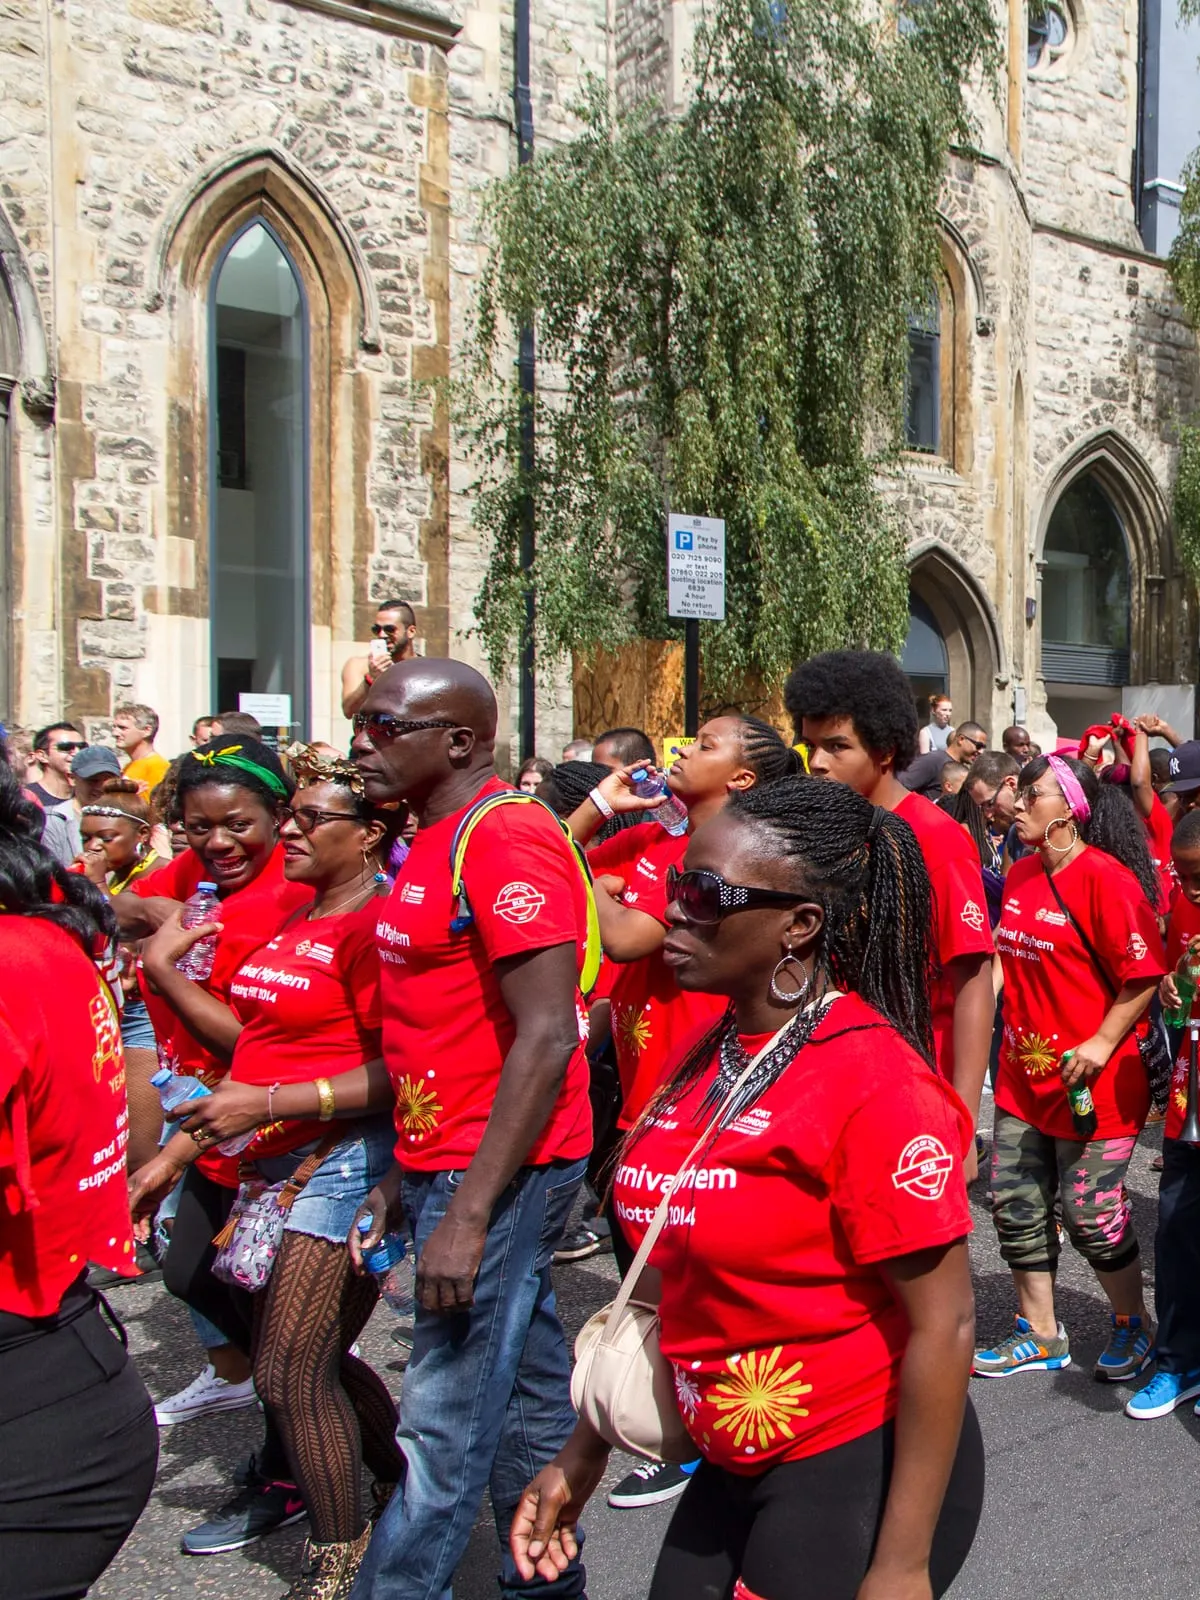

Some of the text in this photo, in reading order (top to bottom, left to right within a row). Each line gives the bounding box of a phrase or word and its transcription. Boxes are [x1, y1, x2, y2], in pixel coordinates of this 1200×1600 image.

[680, 533, 691, 548] P
[998, 927, 1054, 952] nival Mayhem
[93, 1144, 115, 1165] and
[79, 1152, 127, 1192] support
[920, 1161, 937, 1174] BUS
[616, 1200, 657, 1224] Notti
